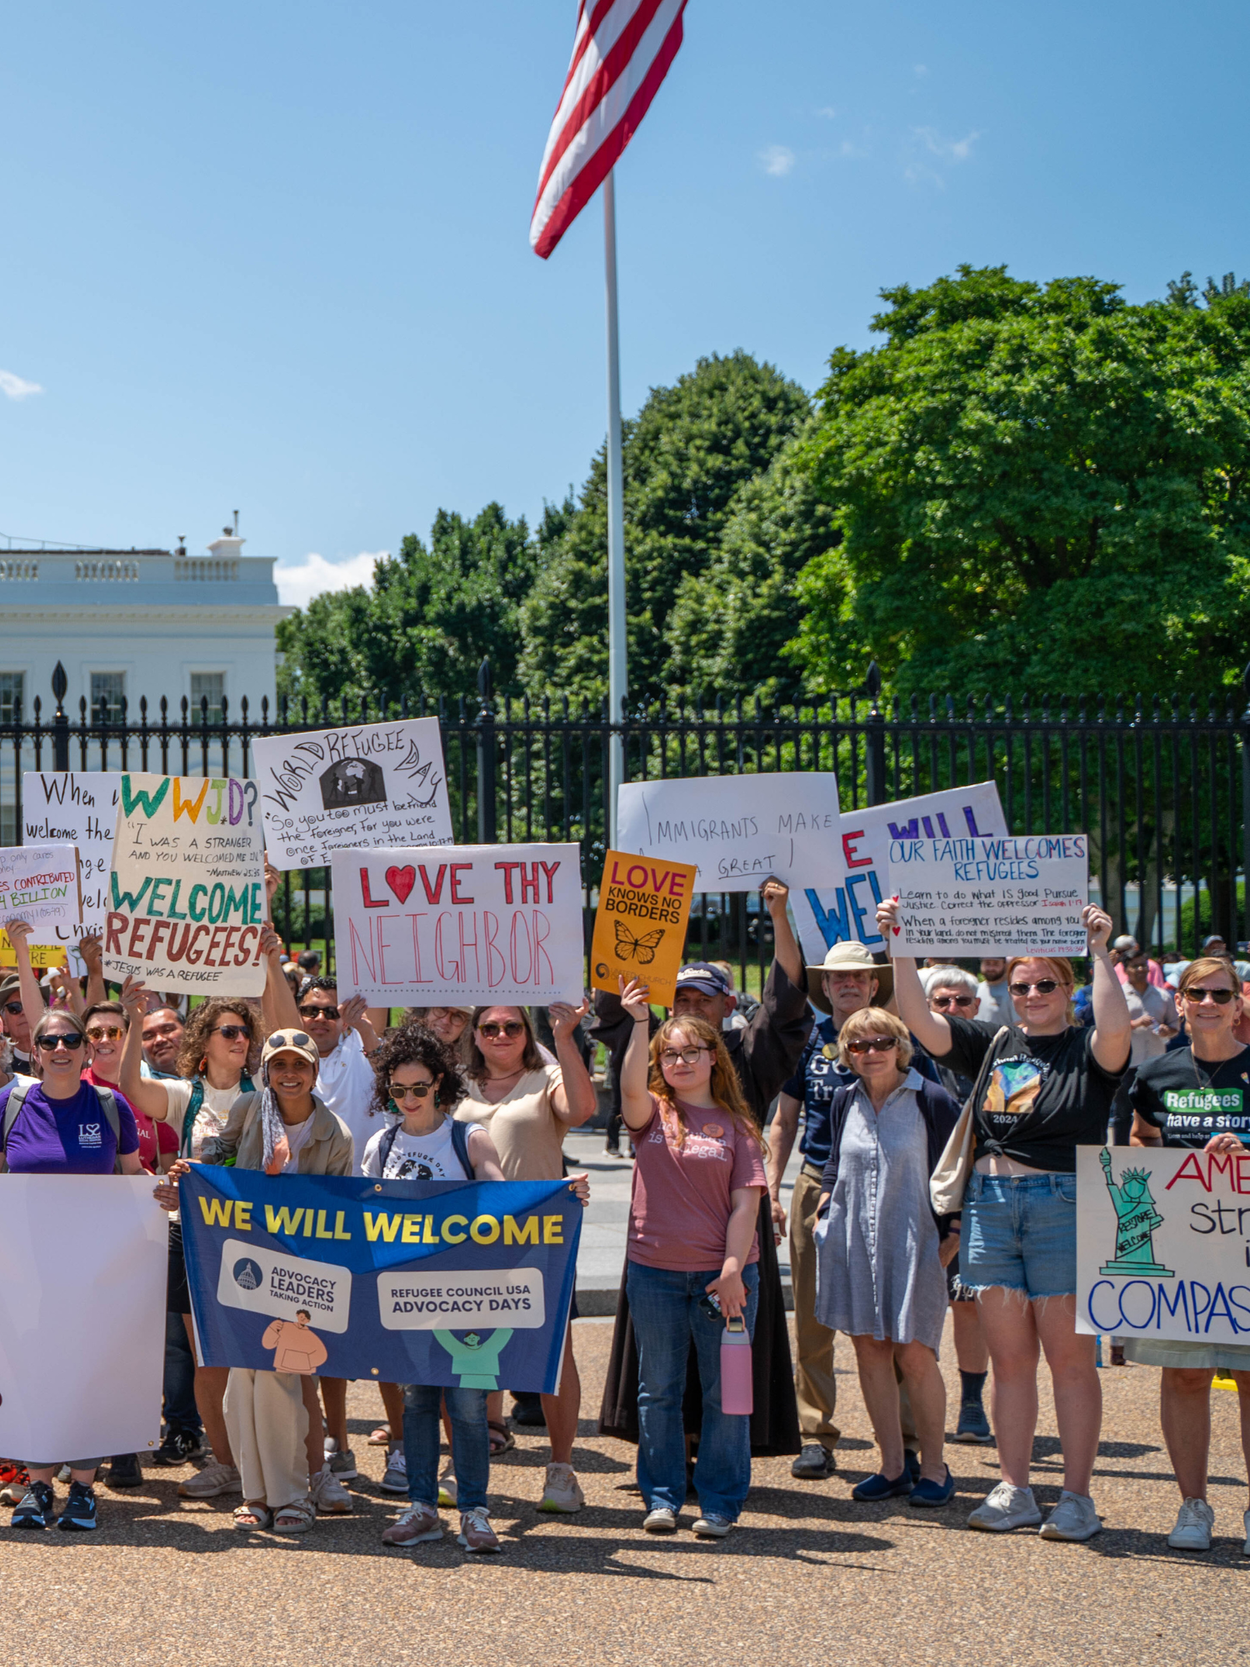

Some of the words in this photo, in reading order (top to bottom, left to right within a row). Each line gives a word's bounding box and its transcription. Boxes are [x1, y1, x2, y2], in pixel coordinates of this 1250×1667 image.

[263, 741, 324, 812] WORLD
[324, 728, 405, 763] REFUGEE
[393, 738, 442, 804] DAY
[40, 773, 95, 807] When
[26, 817, 79, 840] welcome
[85, 816, 115, 840] the
[277, 831, 305, 843] the
[381, 819, 402, 834] you
[406, 814, 436, 826] were
[296, 813, 325, 833] you
[326, 808, 350, 821] too
[778, 812, 833, 834] MAKE
[150, 837, 180, 848] WAS
[189, 838, 199, 849] A
[204, 837, 252, 848] STRANGER
[373, 834, 385, 845] in
[387, 832, 406, 844] the
[889, 840, 925, 863] OUR
[933, 839, 975, 862] FAITH
[982, 837, 1086, 861] WELCOMES
[10, 852, 28, 863] only
[32, 851, 54, 860] cares
[128, 850, 150, 860] AND
[155, 851, 177, 862] YOU
[183, 852, 234, 864] WELCOMED
[235, 851, 246, 862] ME
[14, 871, 75, 891] CONTRIBUTED
[495, 860, 561, 905] THY
[610, 860, 687, 898] LOVE
[954, 860, 1040, 881] REFUGEES
[10, 884, 68, 907] BILLION
[111, 871, 262, 925] WELCOME
[608, 885, 659, 908] KNOWS
[660, 895, 682, 910] NO
[899, 887, 933, 900] Learn
[935, 891, 949, 899] to
[954, 890, 966, 899] do
[971, 889, 996, 899] what
[1017, 889, 1039, 901] good
[1044, 888, 1078, 898] Pursue
[940, 901, 973, 910] Correct
[977, 900, 994, 908] the
[1041, 899, 1067, 908] Isaiah
[605, 898, 681, 925] BORDERS
[901, 915, 935, 927] When
[940, 917, 946, 926] a
[949, 915, 990, 926] foreigner
[994, 915, 1029, 926] resides
[105, 912, 266, 967] REFUGEES!
[348, 909, 555, 987] NEIGHBOR
[145, 967, 166, 978] WAS
[166, 968, 175, 978] A
[177, 971, 223, 982] REFUGEE
[1166, 1092, 1240, 1110] Refugees
[993, 1114, 1018, 1124] 2024
[1166, 1113, 1200, 1127] have
[1203, 1115, 1213, 1127] a
[648, 1131, 664, 1144] is
[1165, 1153, 1250, 1194] AME
[198, 1196, 253, 1231] WE
[264, 1203, 351, 1240] WILL
[363, 1212, 564, 1245] WELCOME
[1118, 1208, 1154, 1234] RESTORE
[1116, 1230, 1151, 1254] WELCOME
[270, 1276, 335, 1303] LEADERS
[271, 1266, 337, 1290] ADVOCACY
[269, 1289, 300, 1304] TAKING
[301, 1299, 334, 1313] ACTION
[391, 1287, 443, 1299] REFUGEE
[446, 1285, 503, 1298] COUNCIL
[505, 1284, 531, 1296] USA
[392, 1299, 483, 1314] ADVOCACY
[489, 1297, 532, 1311] DAYS
[1088, 1280, 1250, 1334] COMPAS
